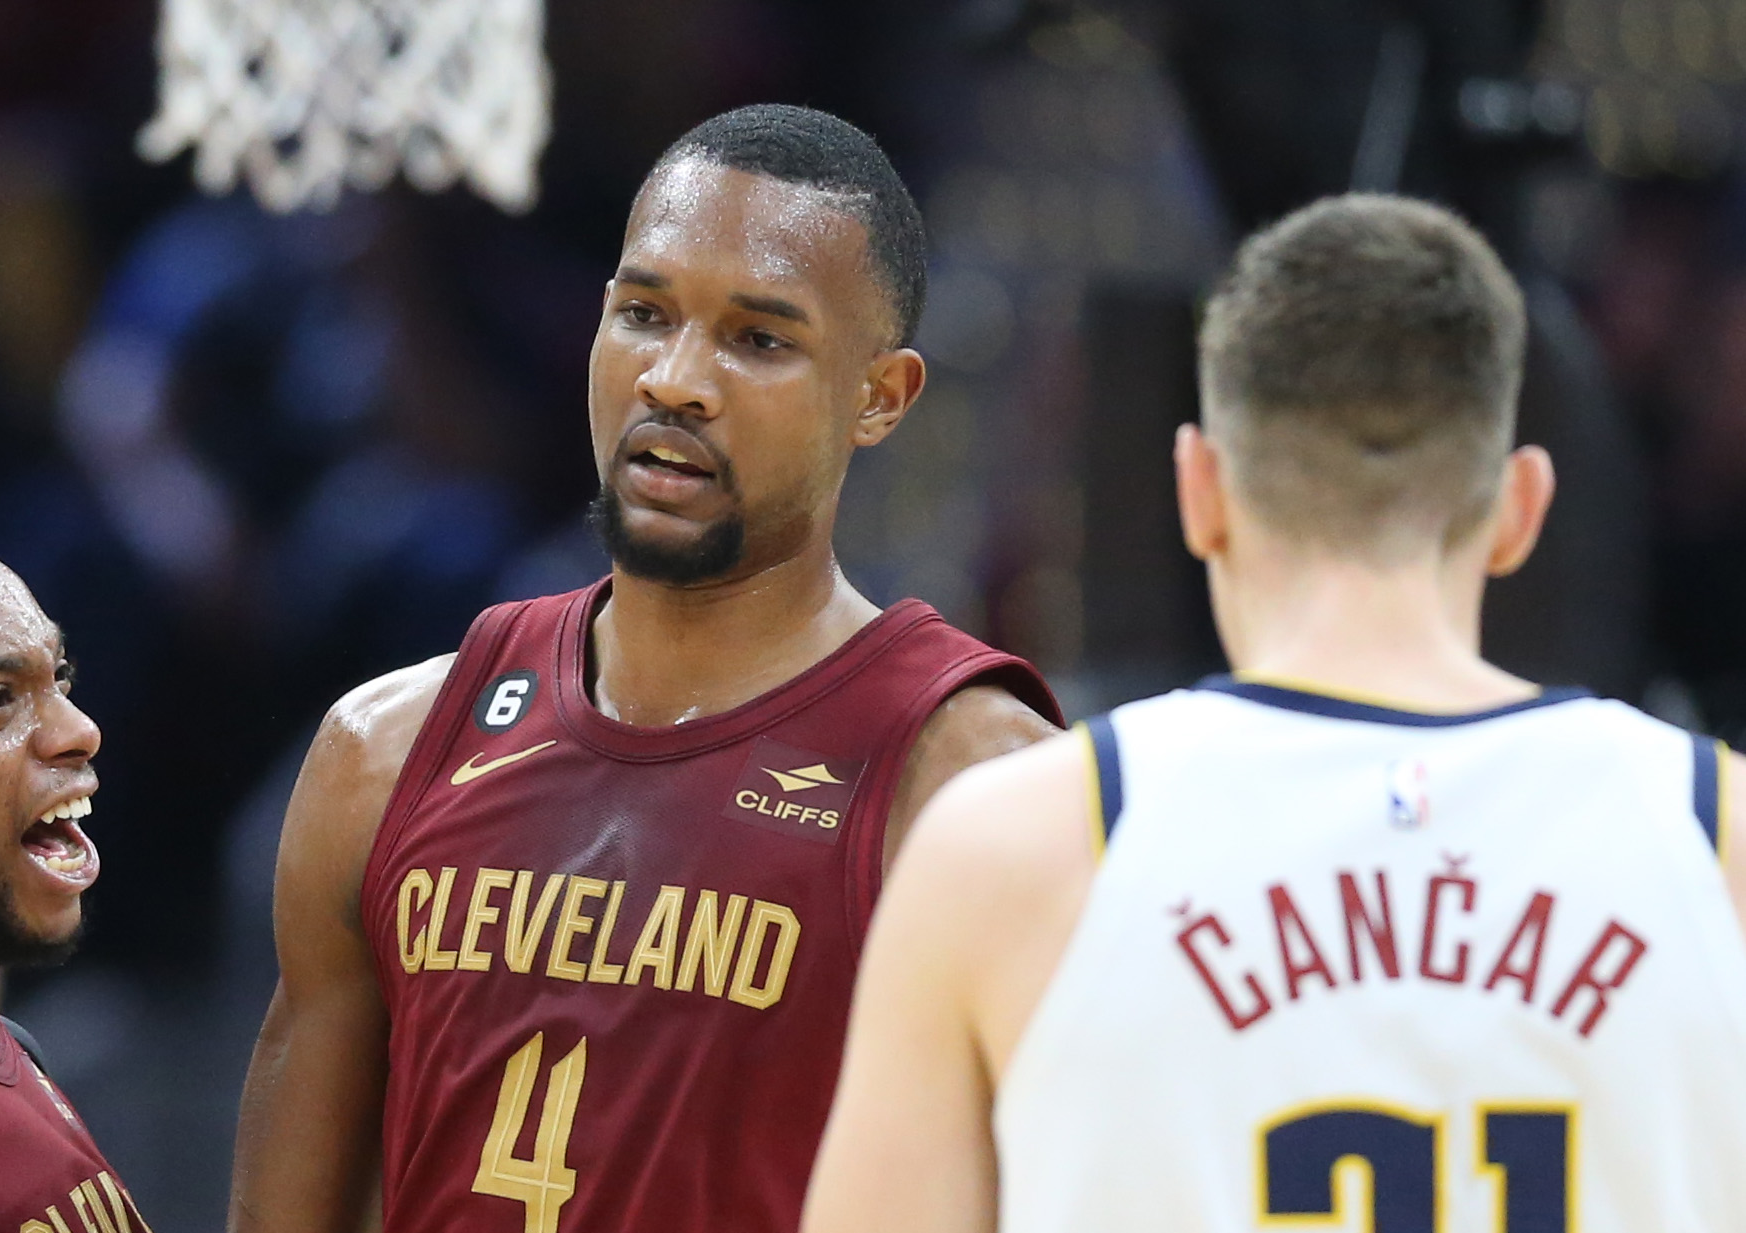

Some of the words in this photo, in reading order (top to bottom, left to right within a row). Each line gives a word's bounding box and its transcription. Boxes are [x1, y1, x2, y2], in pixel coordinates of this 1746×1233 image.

[483, 678, 530, 727] 6
[735, 789, 841, 829] CLIFFS
[395, 866, 802, 1011] CLEVELAND
[1165, 849, 1650, 1040] ČANČAR
